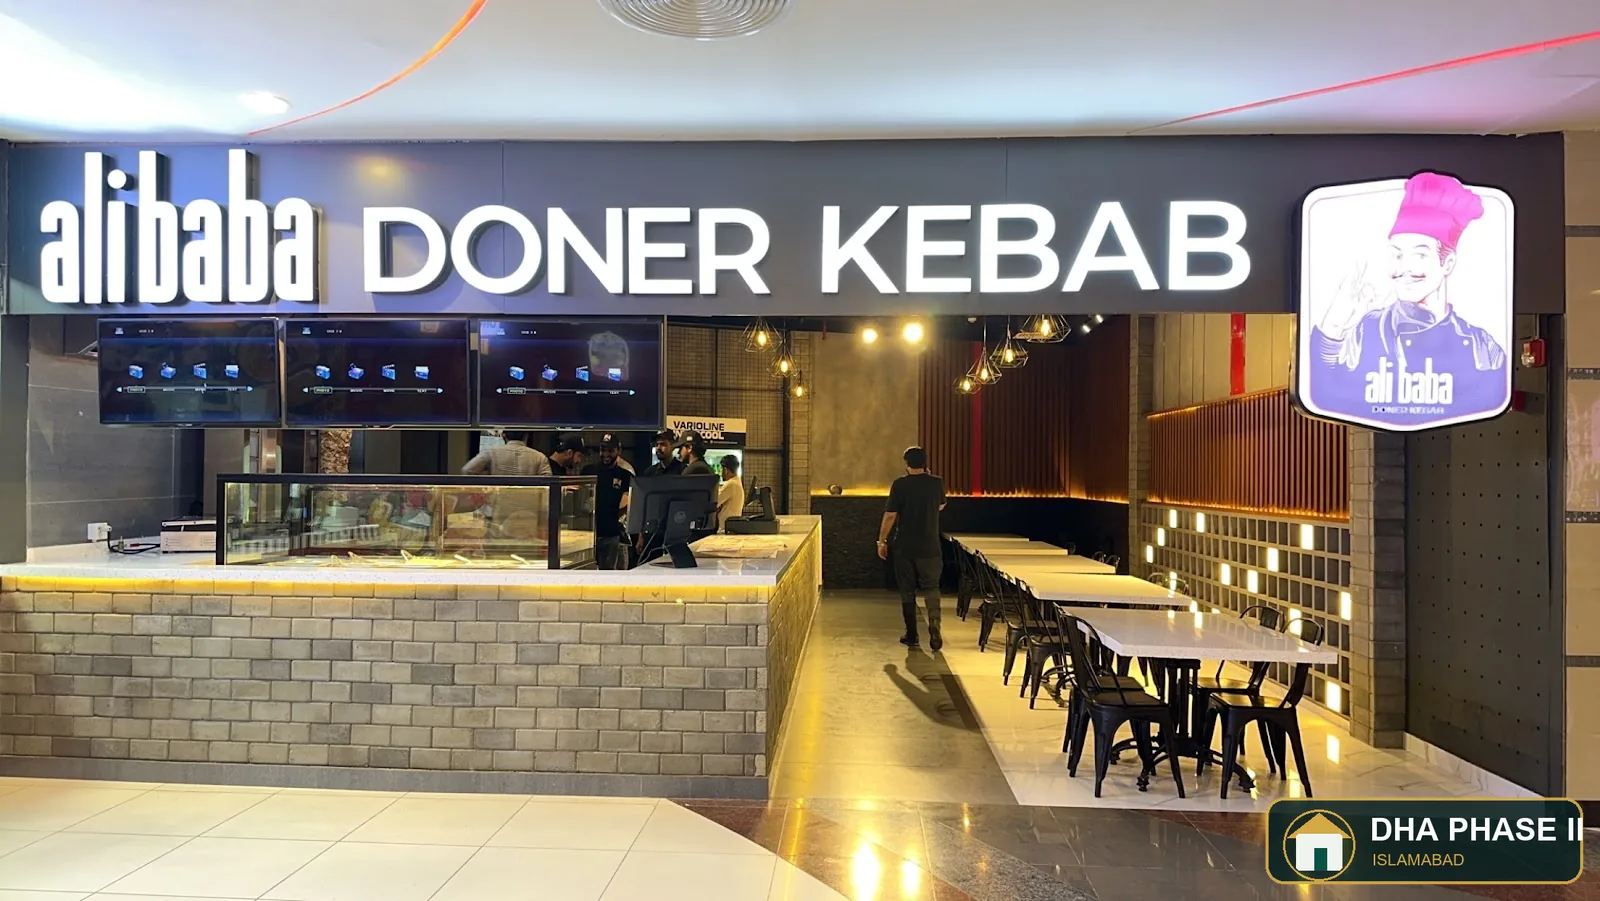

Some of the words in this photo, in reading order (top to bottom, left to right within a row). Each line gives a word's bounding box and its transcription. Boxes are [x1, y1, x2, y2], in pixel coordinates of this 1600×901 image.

[363, 206, 770, 295] DONER
[821, 200, 1252, 294] KEBAB
[1365, 356, 1394, 403] ali
[1397, 356, 1454, 404] baba
[1371, 405, 1409, 414] DONER
[1409, 406, 1445, 415] KEBAB
[673, 421, 725, 431] VARIOLINE
